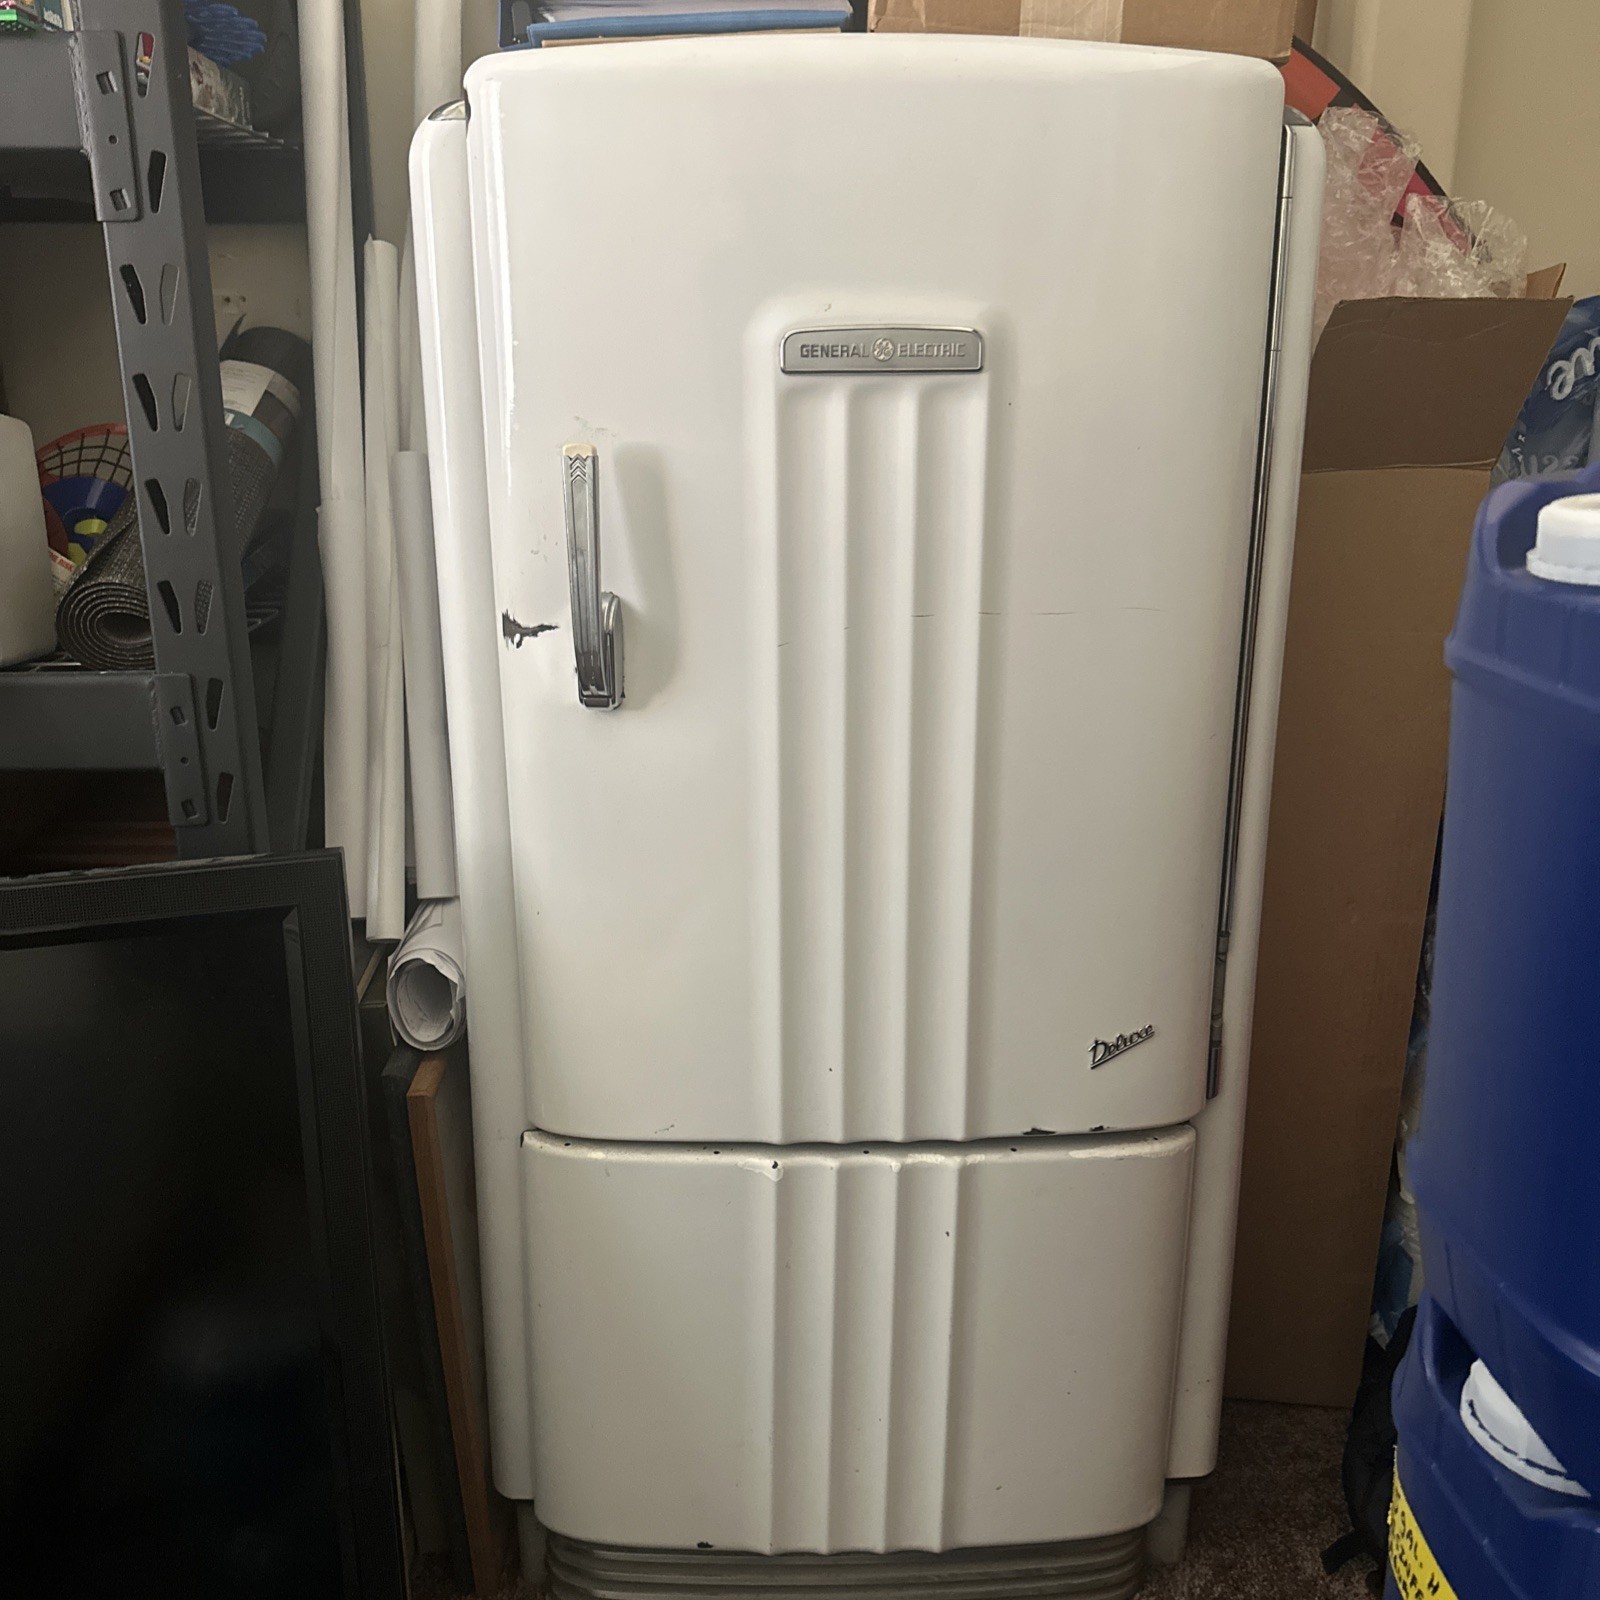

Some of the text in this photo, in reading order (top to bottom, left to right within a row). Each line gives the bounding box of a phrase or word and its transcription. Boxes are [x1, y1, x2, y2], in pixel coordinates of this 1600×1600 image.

[800, 343, 870, 358] GENERAL
[897, 343, 966, 358] ELECTRIC
[1088, 1024, 1153, 1066] Deluxe
